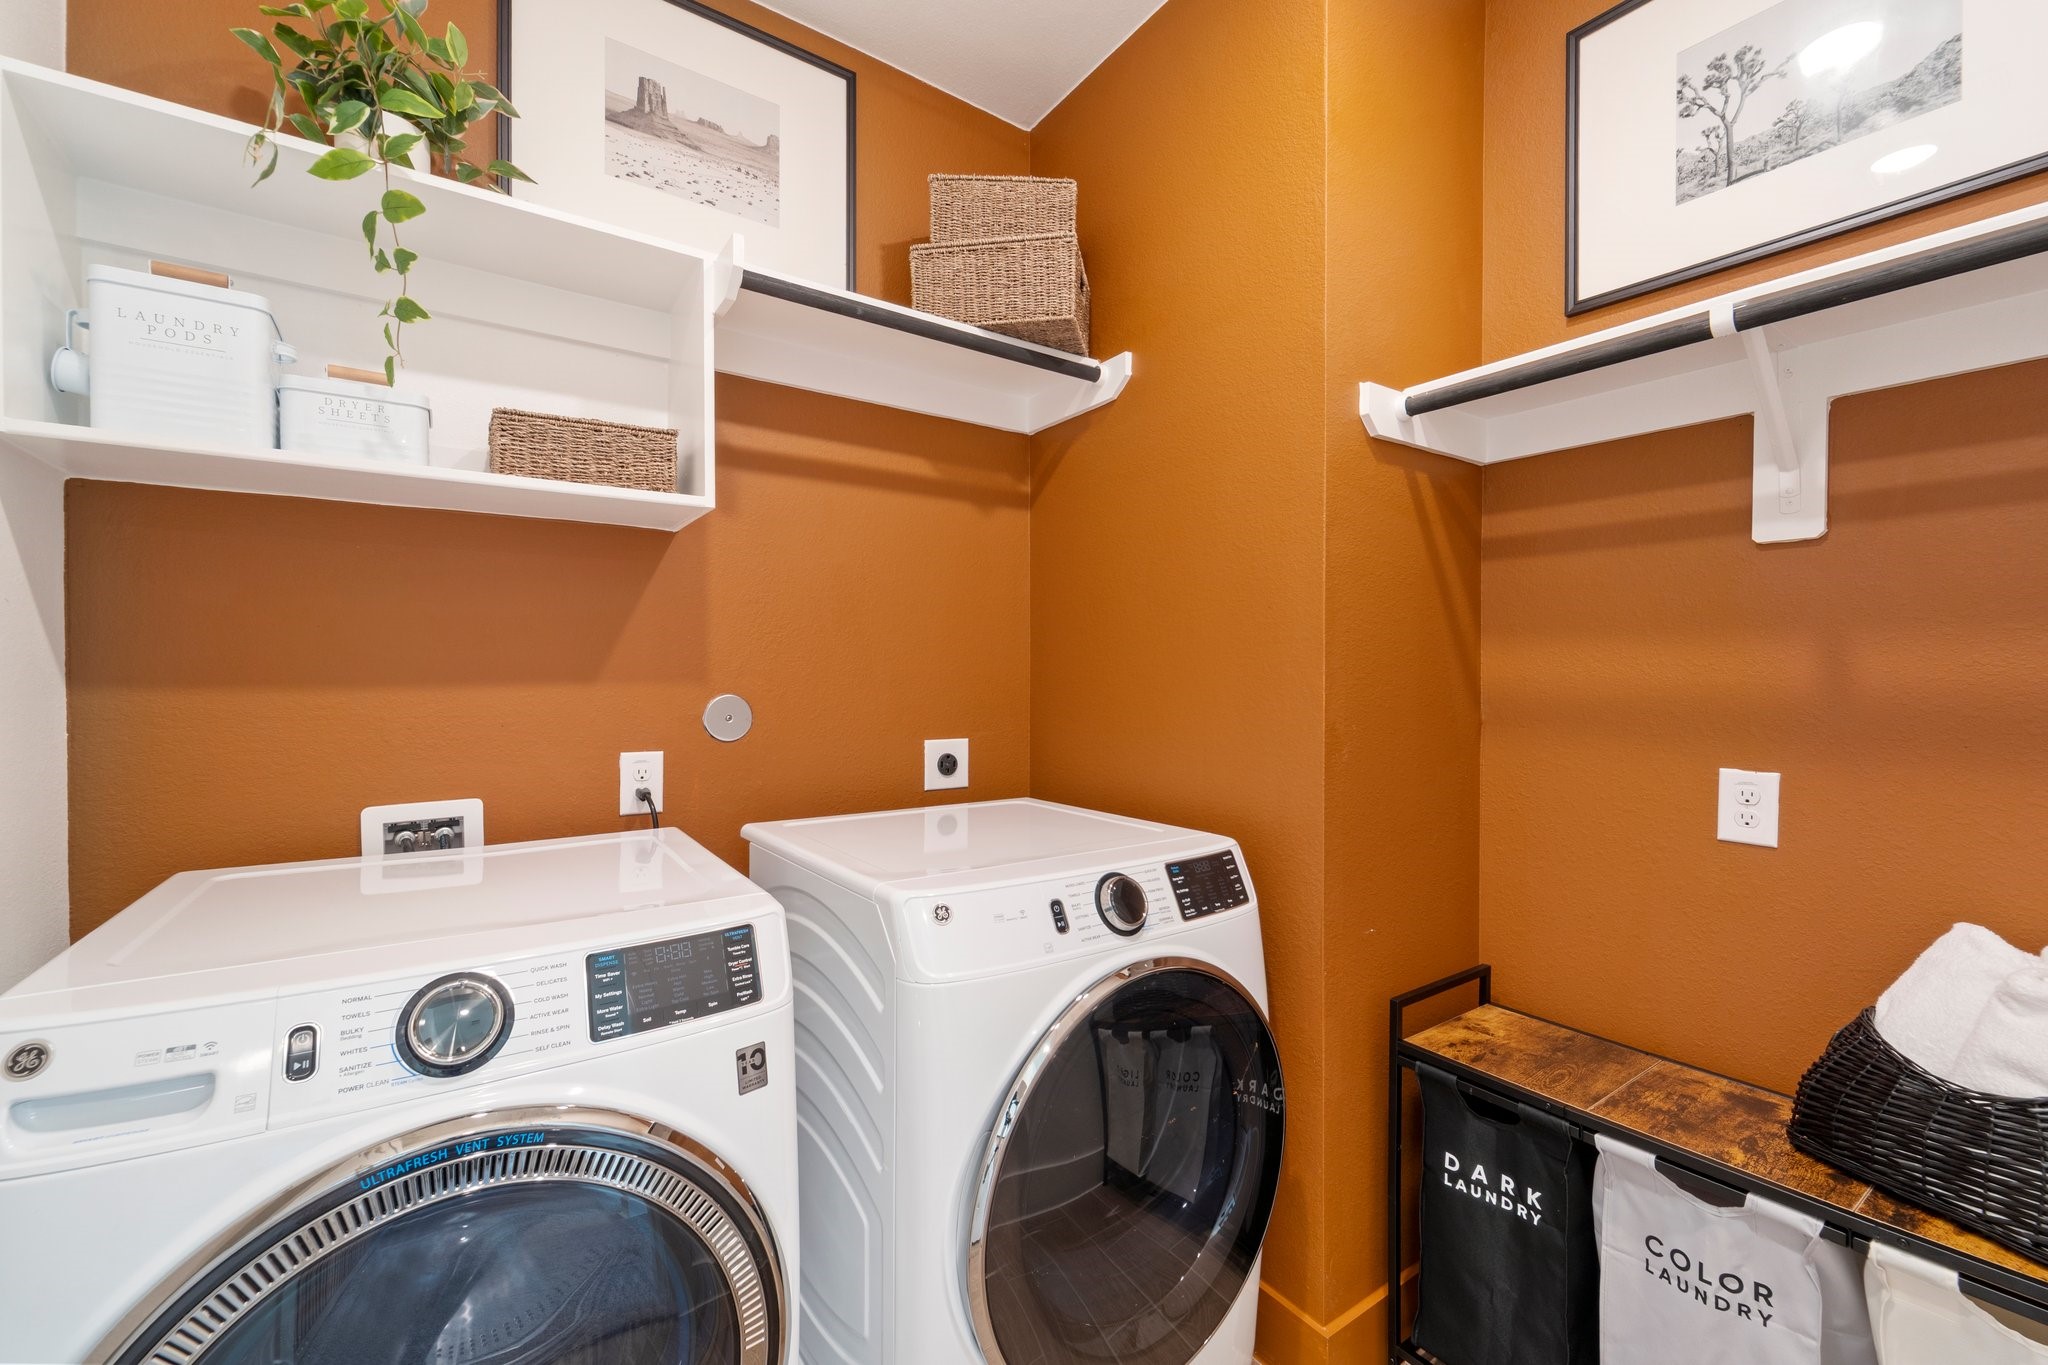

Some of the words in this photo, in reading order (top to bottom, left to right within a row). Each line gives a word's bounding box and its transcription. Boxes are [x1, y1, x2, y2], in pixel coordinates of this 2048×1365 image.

[117, 307, 240, 337] LAUNDRY
[147, 324, 212, 344] PODS
[324, 397, 385, 414] DRYER
[318, 406, 391, 424] SHEETS
[598, 955, 616, 963] SMART
[739, 957, 753, 965] Control
[530, 965, 549, 974] QUICK
[549, 961, 568, 971] WASH
[594, 972, 607, 980] Time
[607, 970, 621, 978] Saver
[731, 975, 743, 983] Extra
[536, 976, 568, 987] DELICATES
[533, 996, 551, 1004] COLD
[551, 992, 569, 1001] WASH
[603, 989, 623, 998] Settings
[341, 995, 373, 1005] NORMAL
[341, 1010, 372, 1021] TOWELS
[529, 1011, 551, 1020] ACTIVE
[551, 1008, 569, 1016] WEAR
[596, 1007, 609, 1015] More
[609, 1004, 624, 1012] Water
[674, 1008, 688, 1016] Temp
[642, 1016, 652, 1024] Soil
[340, 1026, 365, 1036] BULKY
[530, 1028, 549, 1037] RINSE
[556, 1023, 570, 1032] SPIN
[597, 1024, 611, 1033] Delay
[612, 1021, 625, 1029] Wash
[339, 1046, 368, 1057] WHITES
[535, 1043, 550, 1053] SELF
[550, 1040, 571, 1049] CLEAN
[338, 1061, 373, 1074] SANITIZE
[737, 1047, 766, 1076] 10
[337, 1082, 365, 1095] POWER
[365, 1078, 390, 1090] CLEAN
[359, 1148, 449, 1190] ULTRAFRESH
[455, 1138, 490, 1156] VENT
[497, 1132, 545, 1147] SYSTEM
[1443, 1151, 1543, 1211] DARK
[1443, 1175, 1543, 1227] LAUNDRY
[1645, 1234, 1775, 1308] COLOR
[1644, 1257, 1775, 1328] LAUNDRY
